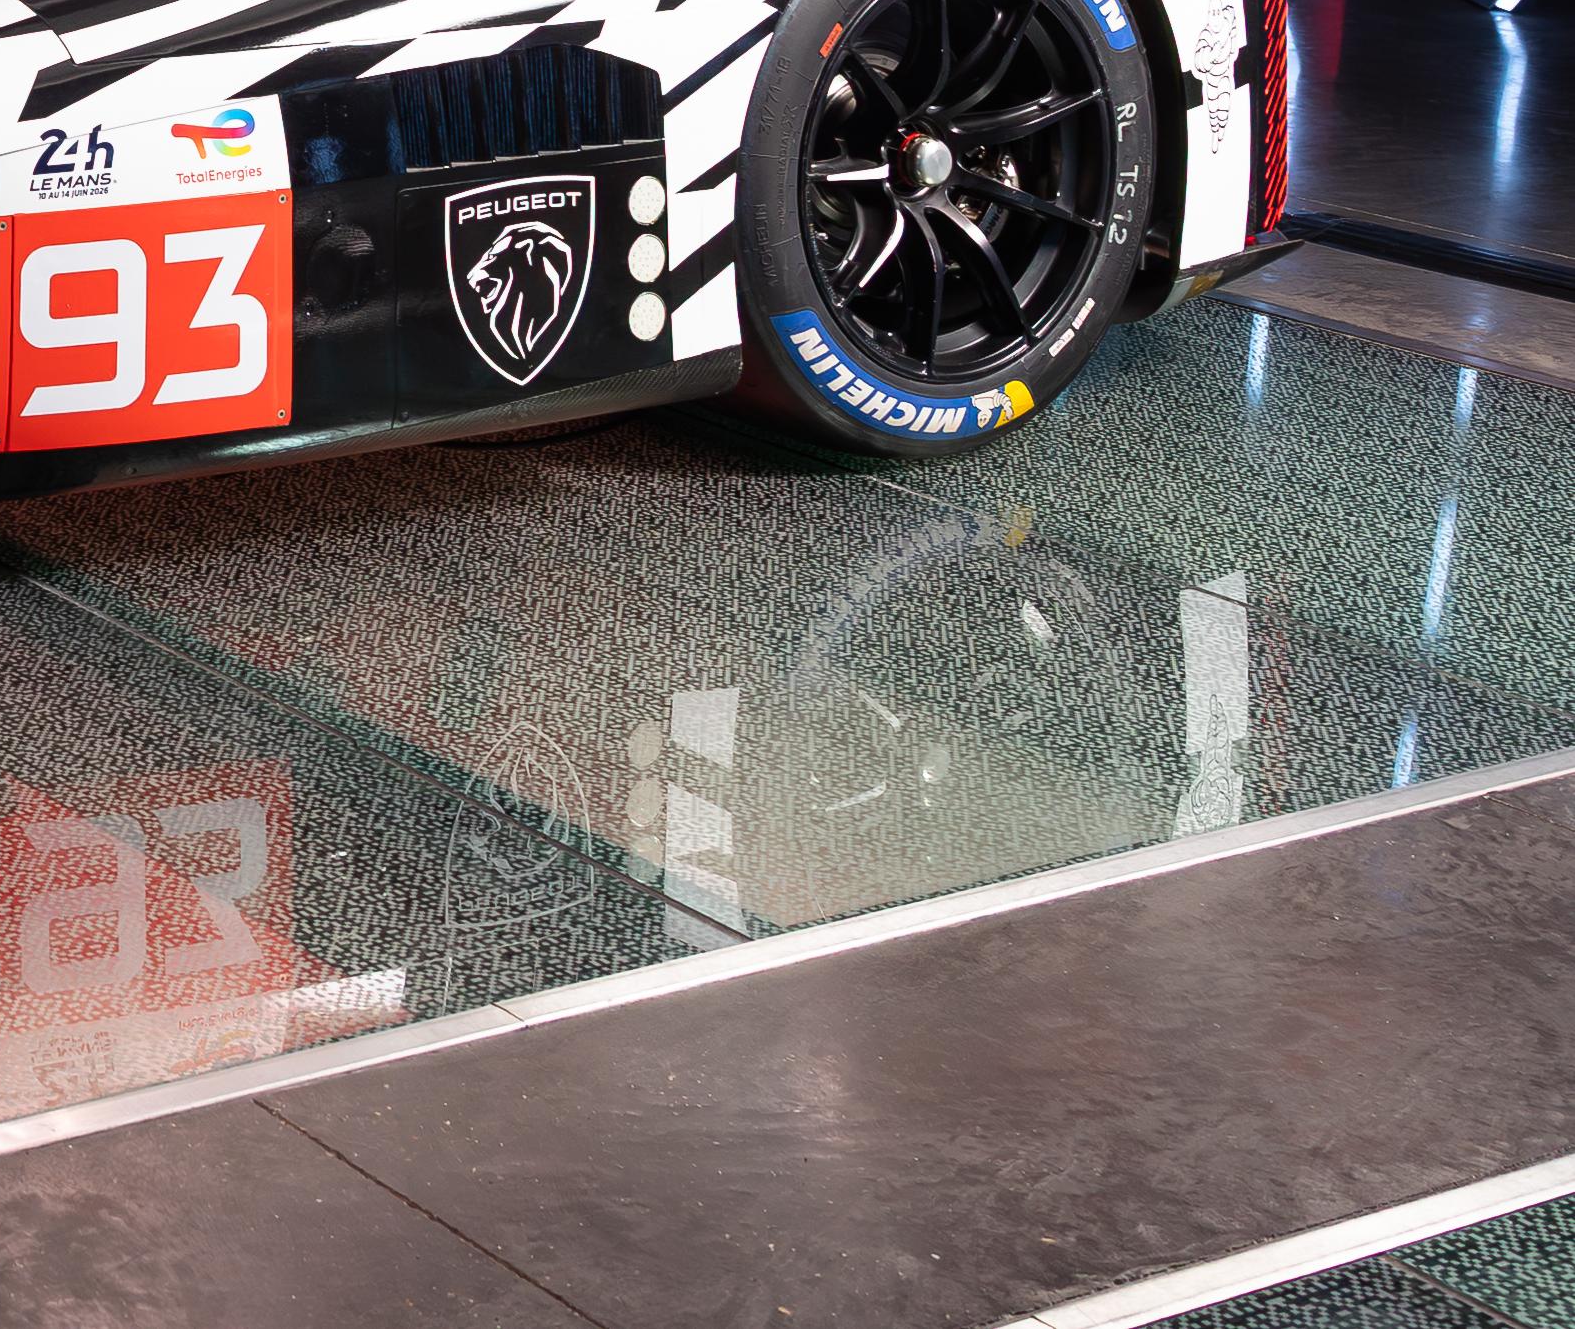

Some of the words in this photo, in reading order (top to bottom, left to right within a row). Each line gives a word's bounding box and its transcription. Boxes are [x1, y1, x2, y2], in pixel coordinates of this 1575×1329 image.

[1116, 102, 1137, 142] RL
[33, 124, 115, 175] 24h
[30, 178, 52, 191] LE
[57, 173, 112, 188] MANS
[39, 192, 47, 200] 10
[49, 191, 60, 199] AU
[62, 190, 70, 198] 14
[71, 189, 89, 198] JUIN
[90, 187, 109, 195] 2026
[176, 167, 262, 184] TotalEnergies
[458, 191, 582, 225] PEUGEOT
[20, 224, 268, 417] 93
[791, 328, 965, 434] MICHELIN
